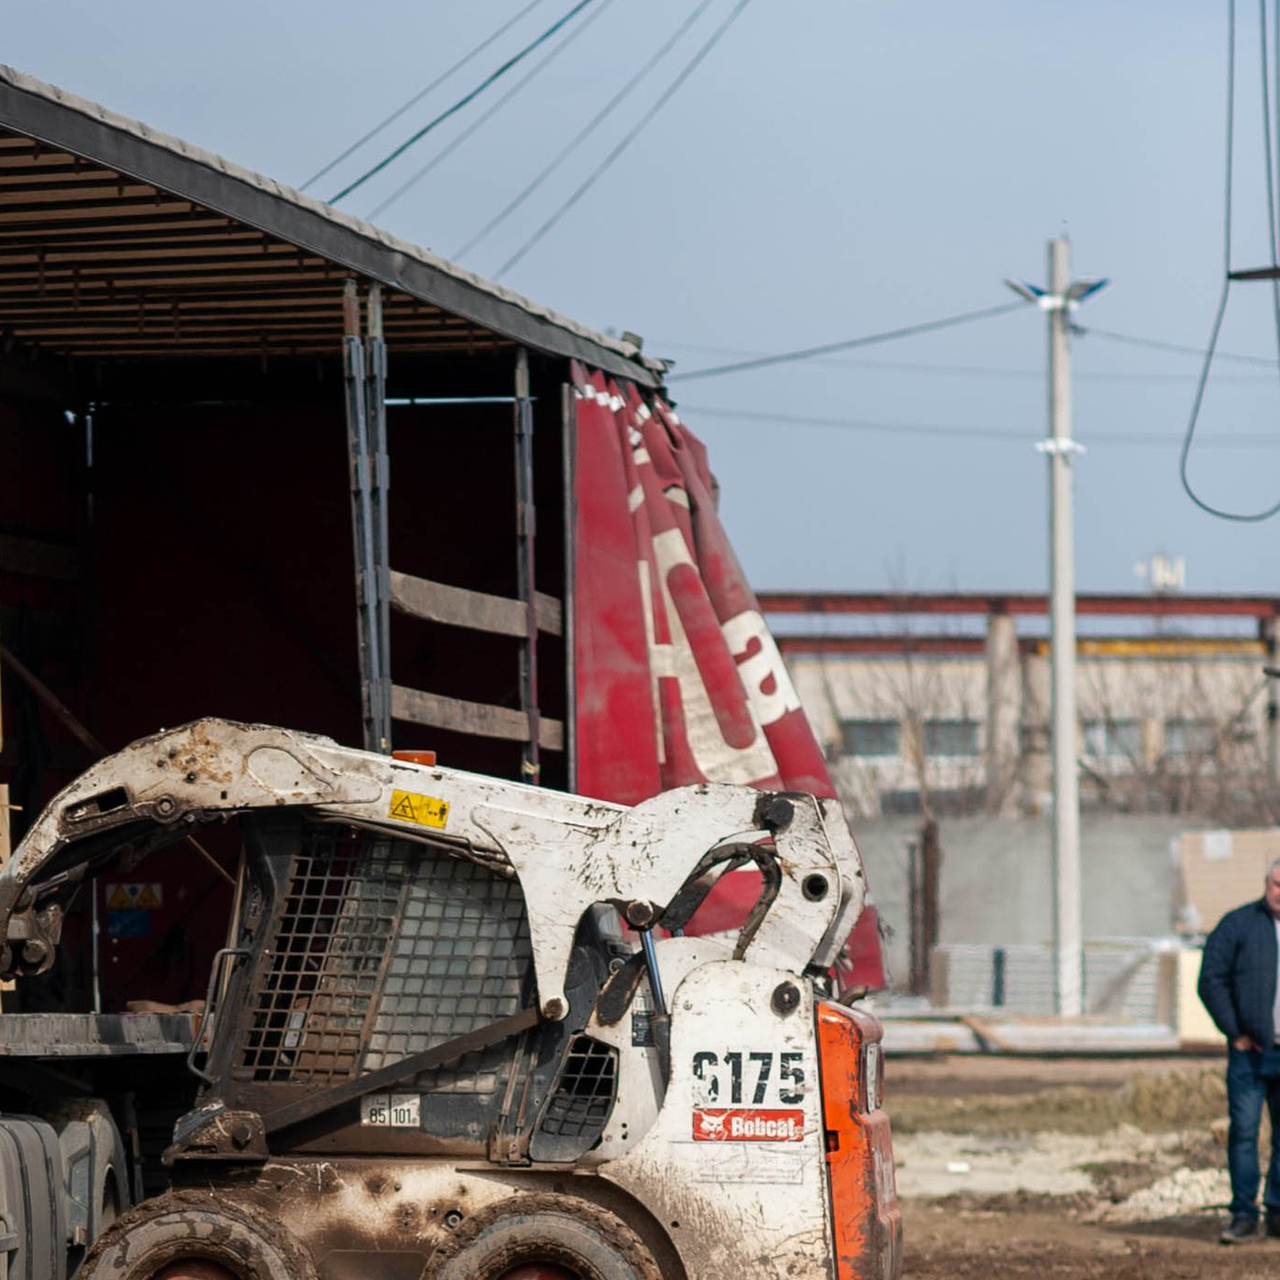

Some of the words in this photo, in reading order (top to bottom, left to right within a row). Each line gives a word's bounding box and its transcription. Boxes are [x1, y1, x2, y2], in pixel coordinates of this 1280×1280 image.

[370, 1108, 386, 1123] 85
[393, 1108, 411, 1123] 101
[731, 1116, 795, 1137] Bobcat
